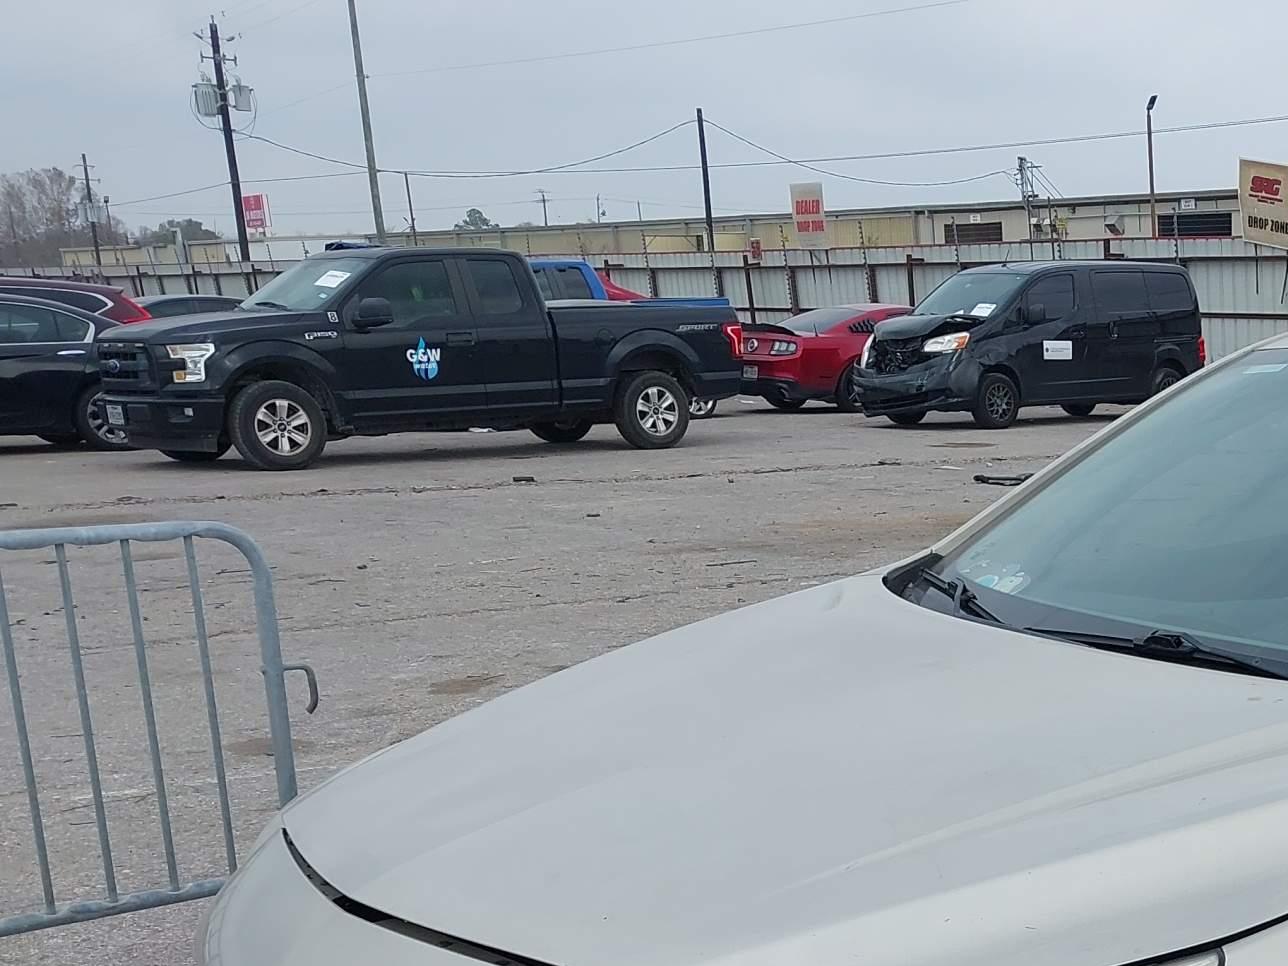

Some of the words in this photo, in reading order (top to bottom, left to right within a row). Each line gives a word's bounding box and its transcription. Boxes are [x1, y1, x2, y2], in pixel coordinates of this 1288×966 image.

[1250, 176, 1282, 196] SRG
[795, 199, 820, 215] DEALER
[1248, 215, 1270, 230] DROP
[676, 324, 717, 332] SPORT
[406, 348, 441, 361] G&W
